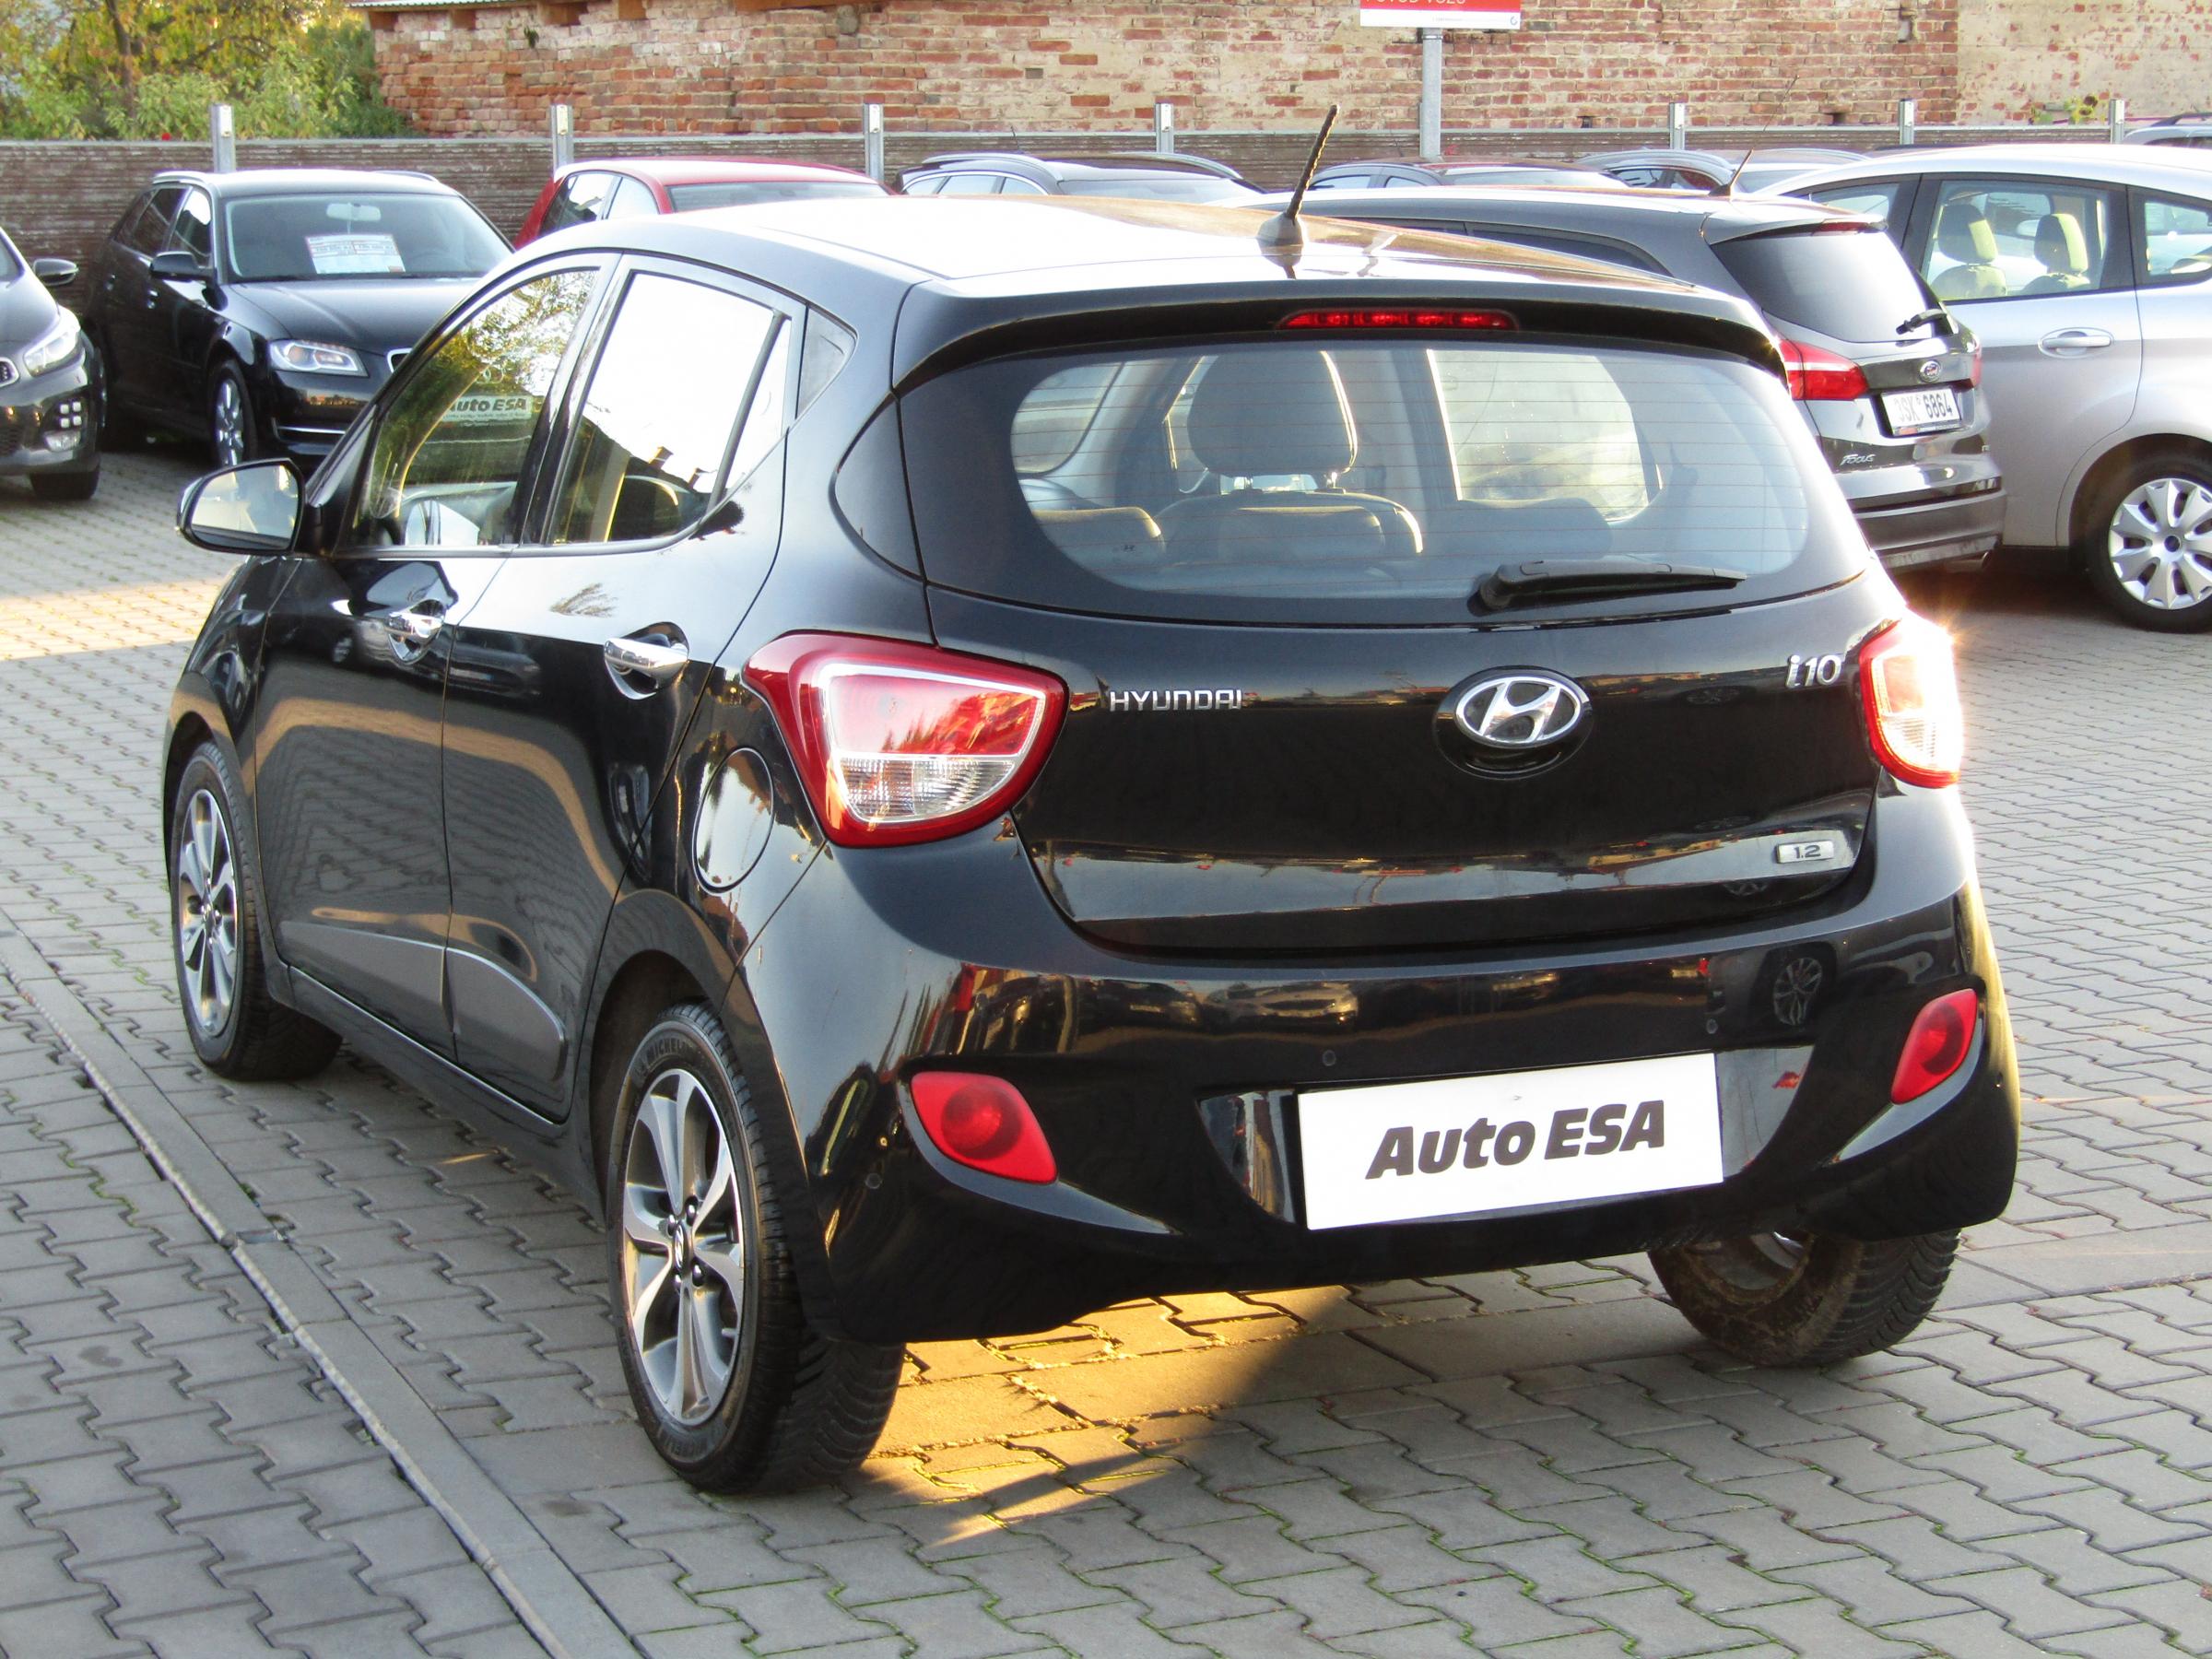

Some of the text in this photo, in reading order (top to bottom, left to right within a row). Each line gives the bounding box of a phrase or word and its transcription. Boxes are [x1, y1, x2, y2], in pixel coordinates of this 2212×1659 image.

[493, 398, 526, 411] ESA
[1923, 393, 1954, 418] 6864
[1785, 654, 1841, 688] i10
[1109, 688, 1242, 712] HYUNDAI
[1794, 844, 1821, 859] 1.2
[1365, 1100, 1665, 1180] Auto ESA
